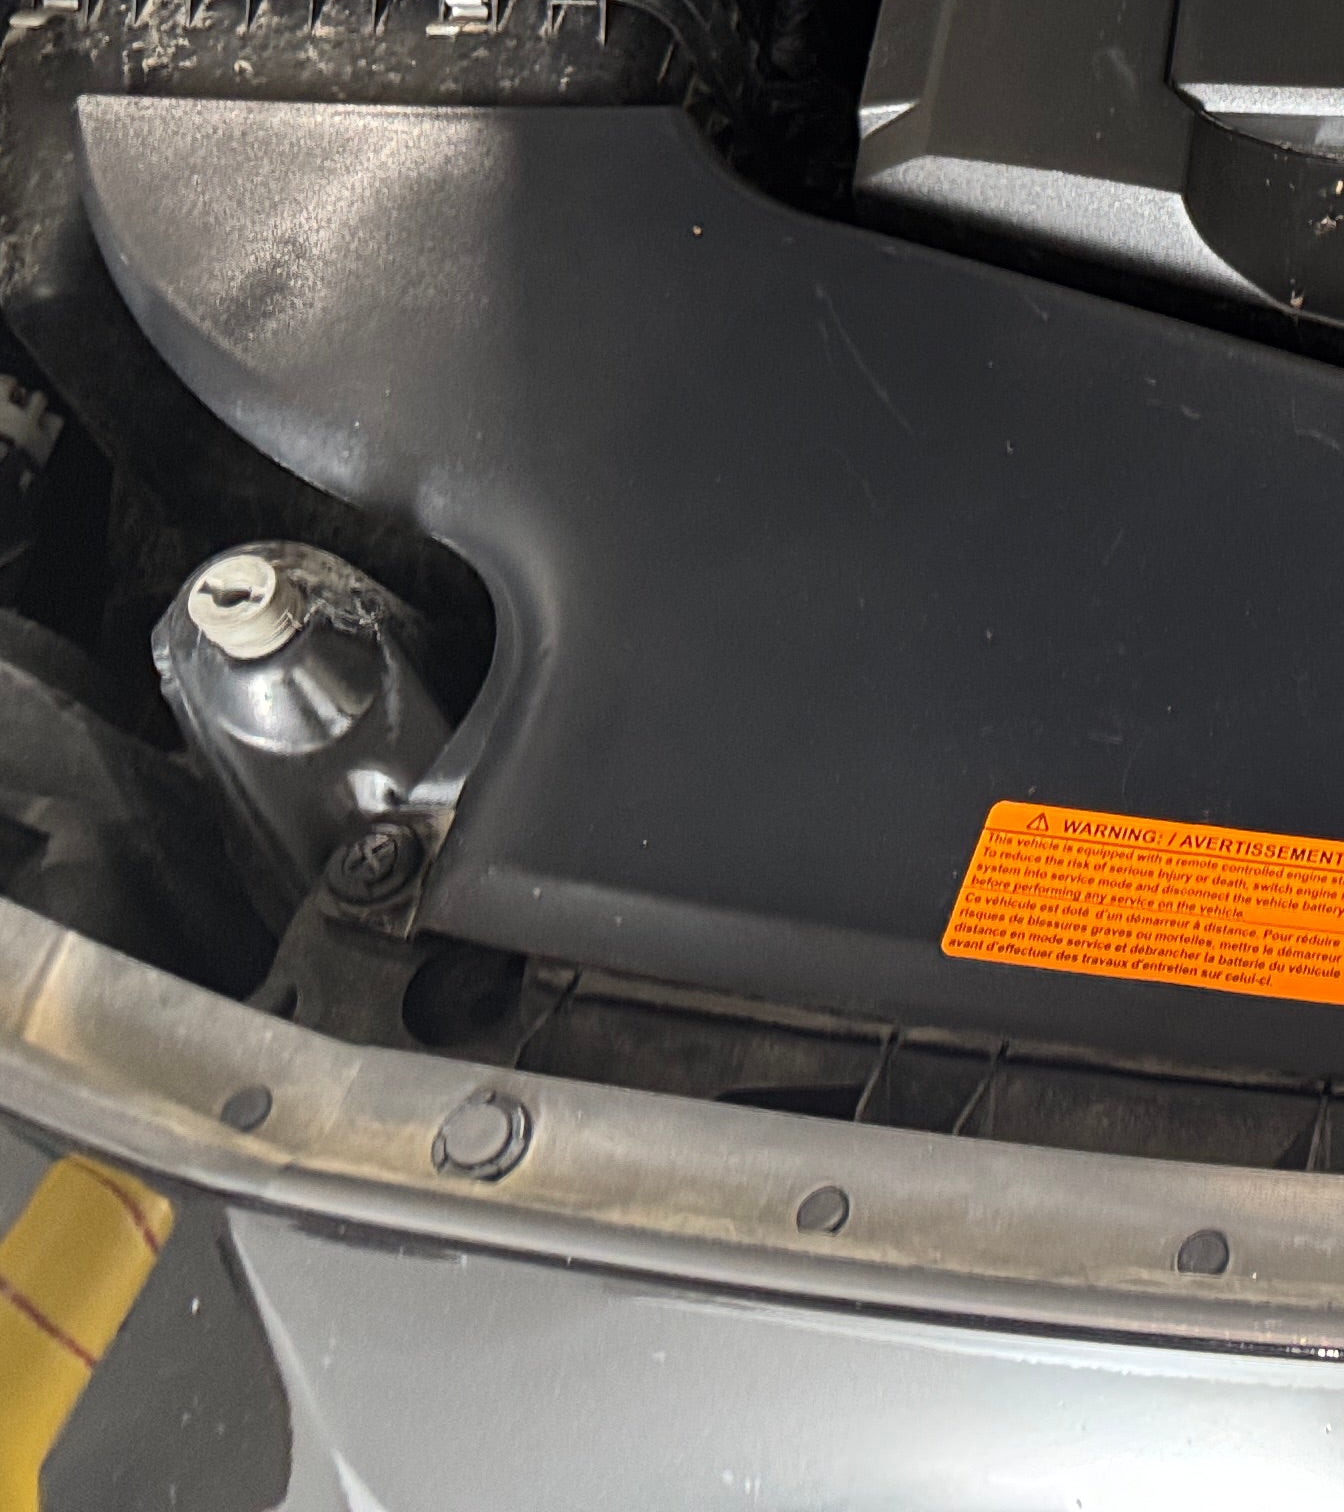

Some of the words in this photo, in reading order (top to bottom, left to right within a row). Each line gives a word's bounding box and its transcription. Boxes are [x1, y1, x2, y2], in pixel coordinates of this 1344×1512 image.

[1064, 819, 1163, 844] WARNING:
[1167, 832, 1177, 846] /
[984, 846, 996, 857] To
[1000, 850, 1041, 863] reduce
[1045, 855, 1064, 866] the
[1067, 858, 1089, 870] risk
[1094, 862, 1107, 872] of
[1109, 865, 1154, 878] serious
[1196, 875, 1209, 883] or
[1253, 883, 1292, 894] switch
[1296, 888, 1337, 900] engine
[989, 832, 1013, 845] This
[1017, 838, 1059, 851] vehicle
[1063, 842, 1073, 853] is
[1077, 846, 1134, 861] equipped
[1137, 854, 1162, 864] with
[1176, 858, 1218, 871] remote
[1222, 863, 1284, 879] controlled
[1287, 872, 1327, 888] engine
[971, 874, 1010, 891] before
[1011, 883, 1081, 902] performing
[1084, 892, 1107, 905] any
[1110, 895, 1154, 908] service
[1158, 901, 1173, 911] on
[1177, 901, 1196, 914] the
[975, 863, 1020, 876] system
[1024, 866, 1047, 879] into
[1051, 873, 1095, 886] service
[1098, 878, 1132, 890] mode
[1136, 883, 1160, 893] and
[1162, 884, 1230, 902] disconnect
[1233, 893, 1252, 905] the
[1256, 896, 1299, 910] vehicle
[1302, 901, 1344, 918] battery
[959, 908, 1005, 922] risques
[1009, 914, 1024, 924] de
[1027, 915, 1087, 933] blessures
[1091, 926, 1132, 938] graves
[1136, 931, 1152, 940] ou
[1220, 941, 1259, 953] mettre
[1263, 944, 1273, 955] le
[965, 892, 981, 903] Ce
[1040, 904, 1059, 914] est
[1096, 909, 1122, 921] d'un
[1263, 929, 1293, 941] Pour
[949, 939, 984, 950] avant
[986, 941, 1053, 959] d'effectuer
[1056, 950, 1078, 962] des
[1082, 953, 1128, 968] travaux
[1131, 959, 1197, 976] d'entretien
[1201, 969, 1223, 980] sur
[954, 922, 1007, 937] distance
[1010, 931, 1025, 940] en
[1029, 933, 1063, 945] mode
[1067, 938, 1111, 951] service
[1115, 943, 1127, 953] et
[1204, 952, 1215, 963] la
[1218, 954, 1265, 970] batterie
[1269, 961, 1285, 973] du
